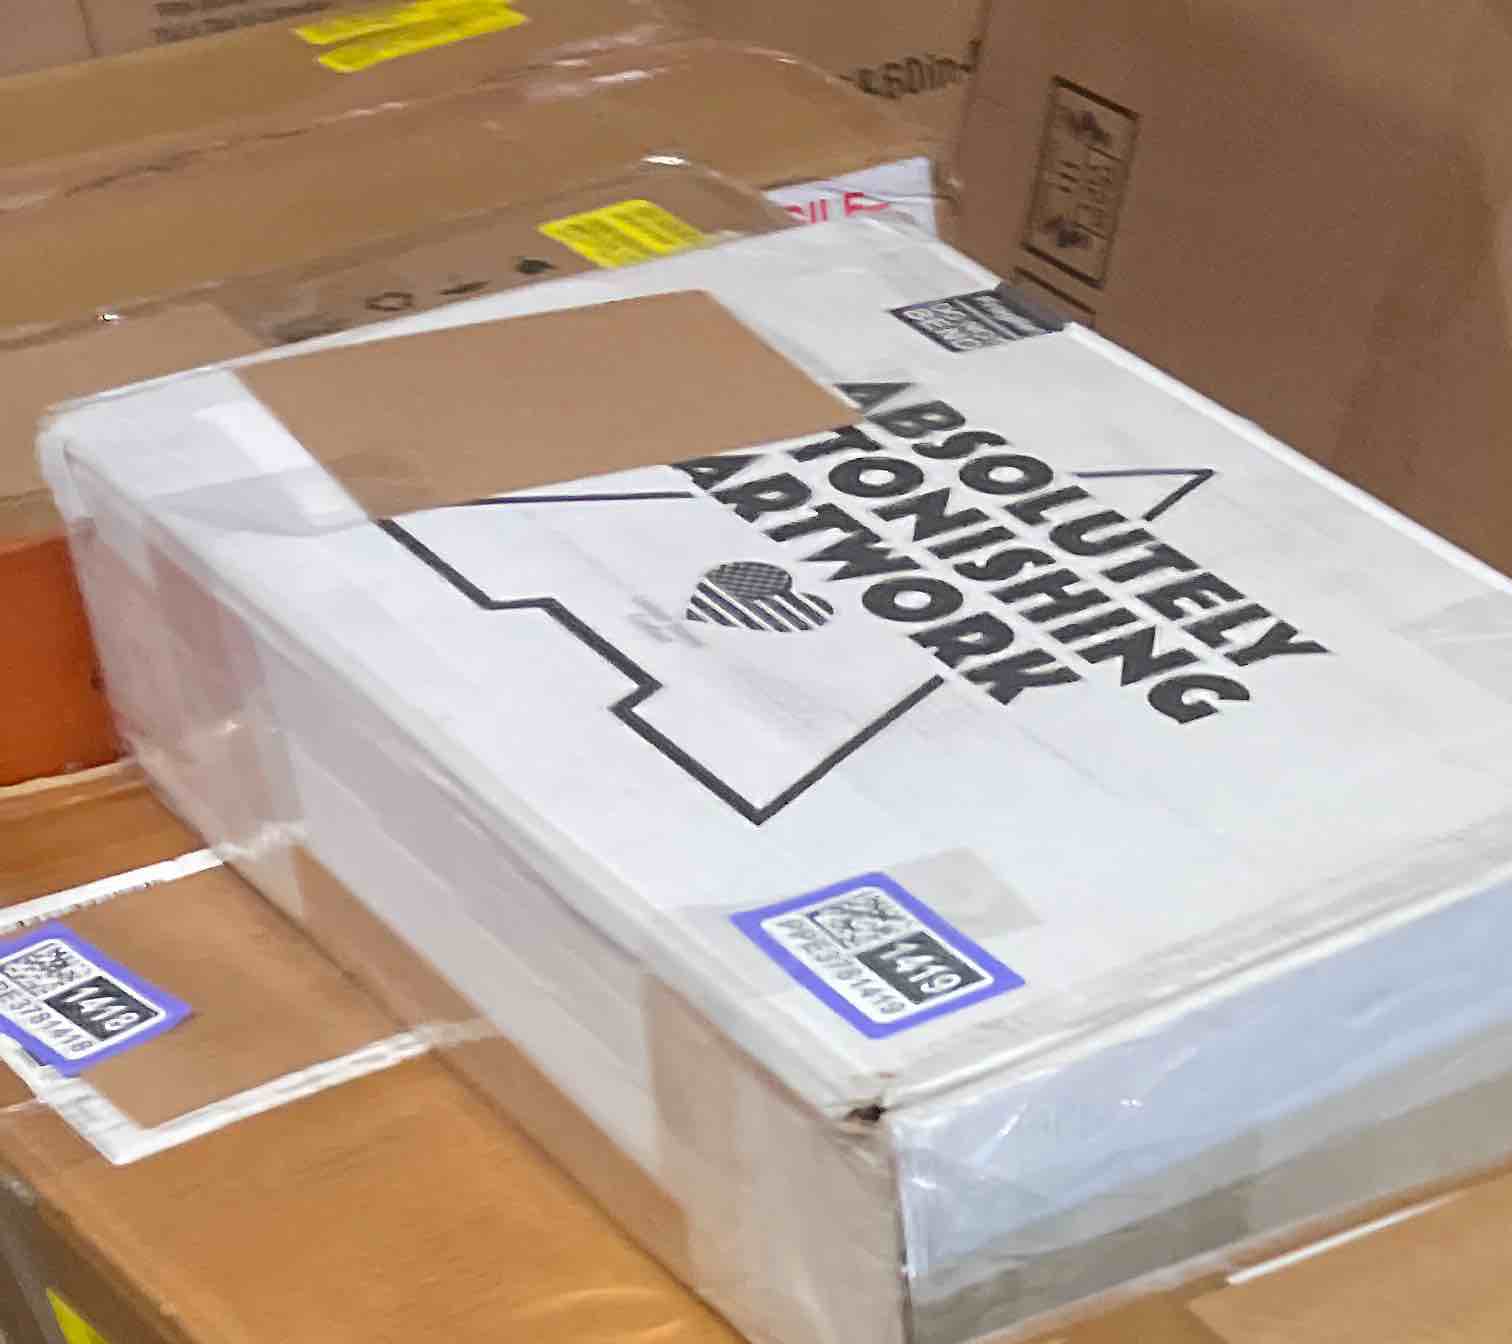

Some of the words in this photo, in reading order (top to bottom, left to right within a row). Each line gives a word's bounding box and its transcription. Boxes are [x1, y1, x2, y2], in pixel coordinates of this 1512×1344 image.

[668, 453, 1084, 706] ARTWORK
[832, 381, 1329, 667] ABSOLUTELY
[62, 986, 140, 1032] 1418
[879, 942, 962, 993] 1419
